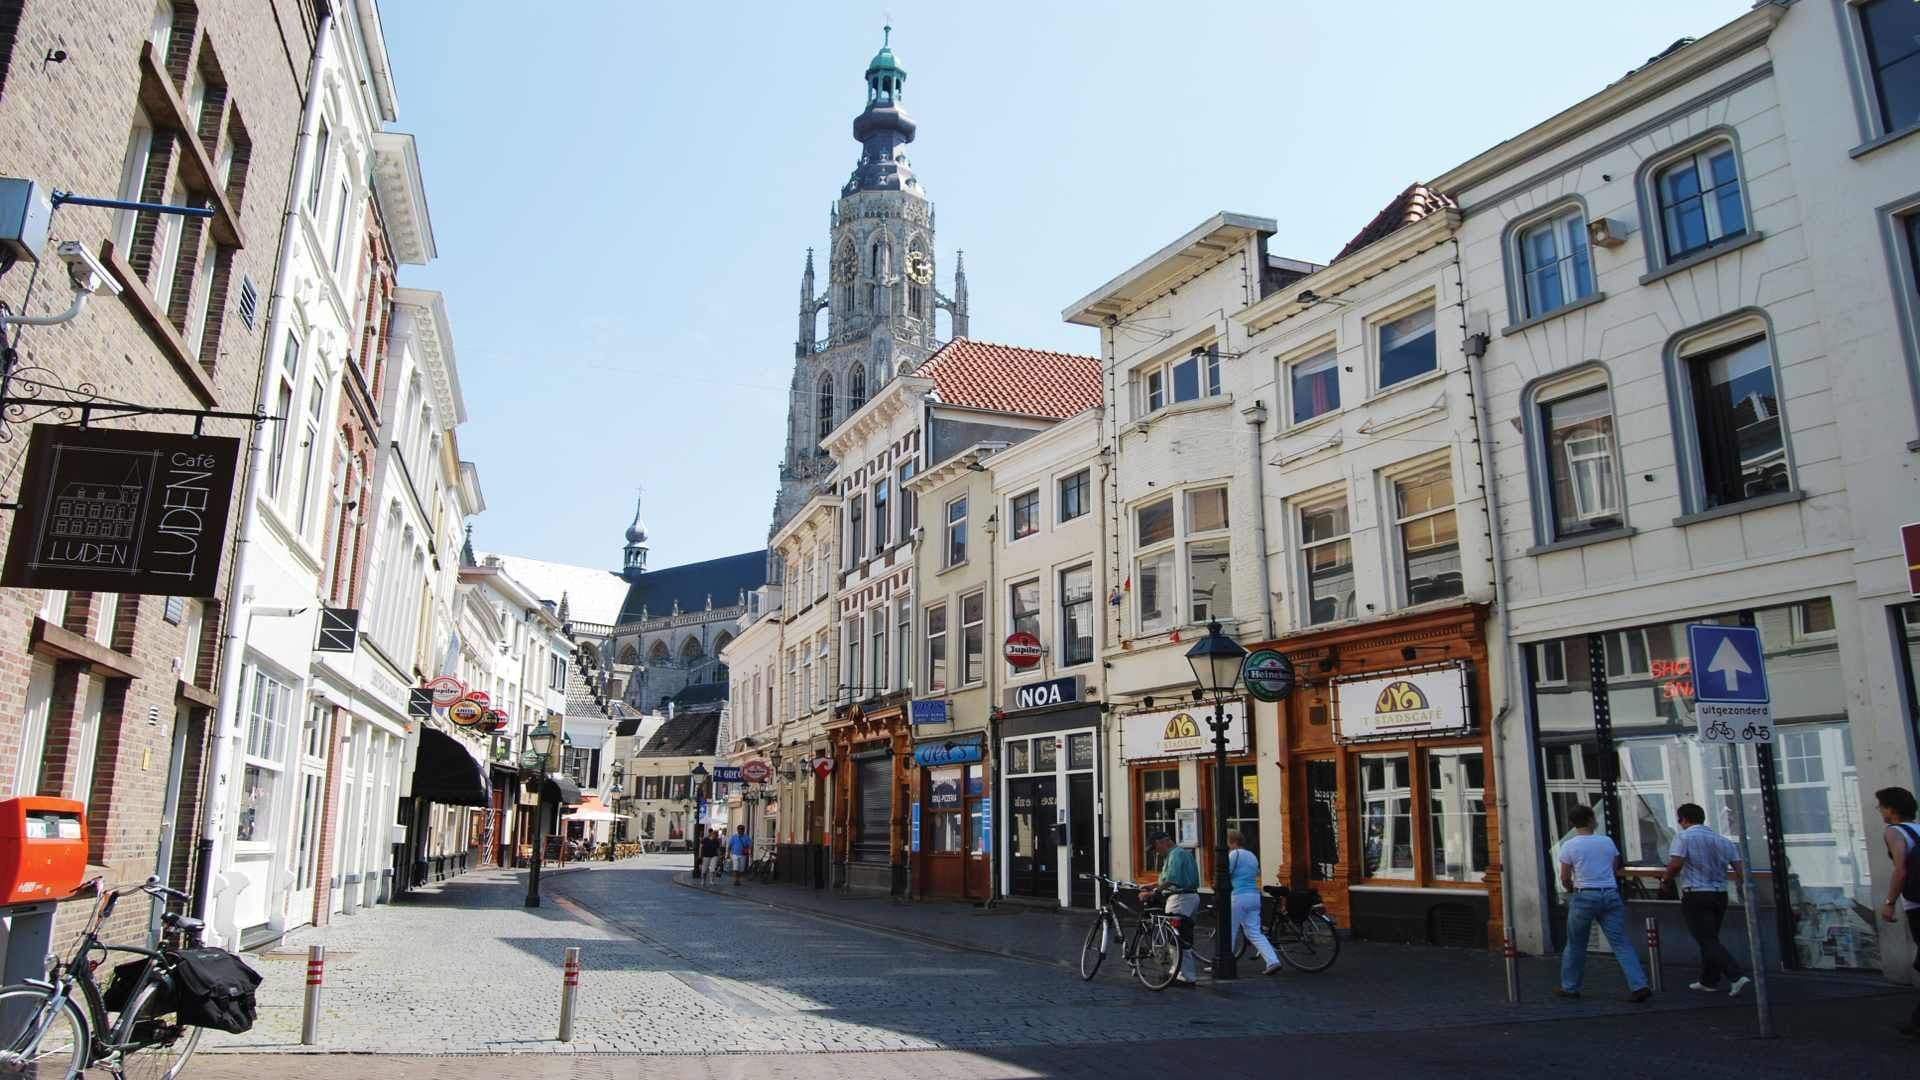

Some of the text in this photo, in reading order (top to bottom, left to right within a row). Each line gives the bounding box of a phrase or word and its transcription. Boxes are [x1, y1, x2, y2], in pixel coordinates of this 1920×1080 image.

[171, 452, 216, 469] Café
[149, 469, 214, 581] LUDEN
[48, 541, 128, 565] LUDEN
[1009, 645, 1041, 655] Jupiler
[1702, 706, 1769, 717] uitgezonderd
